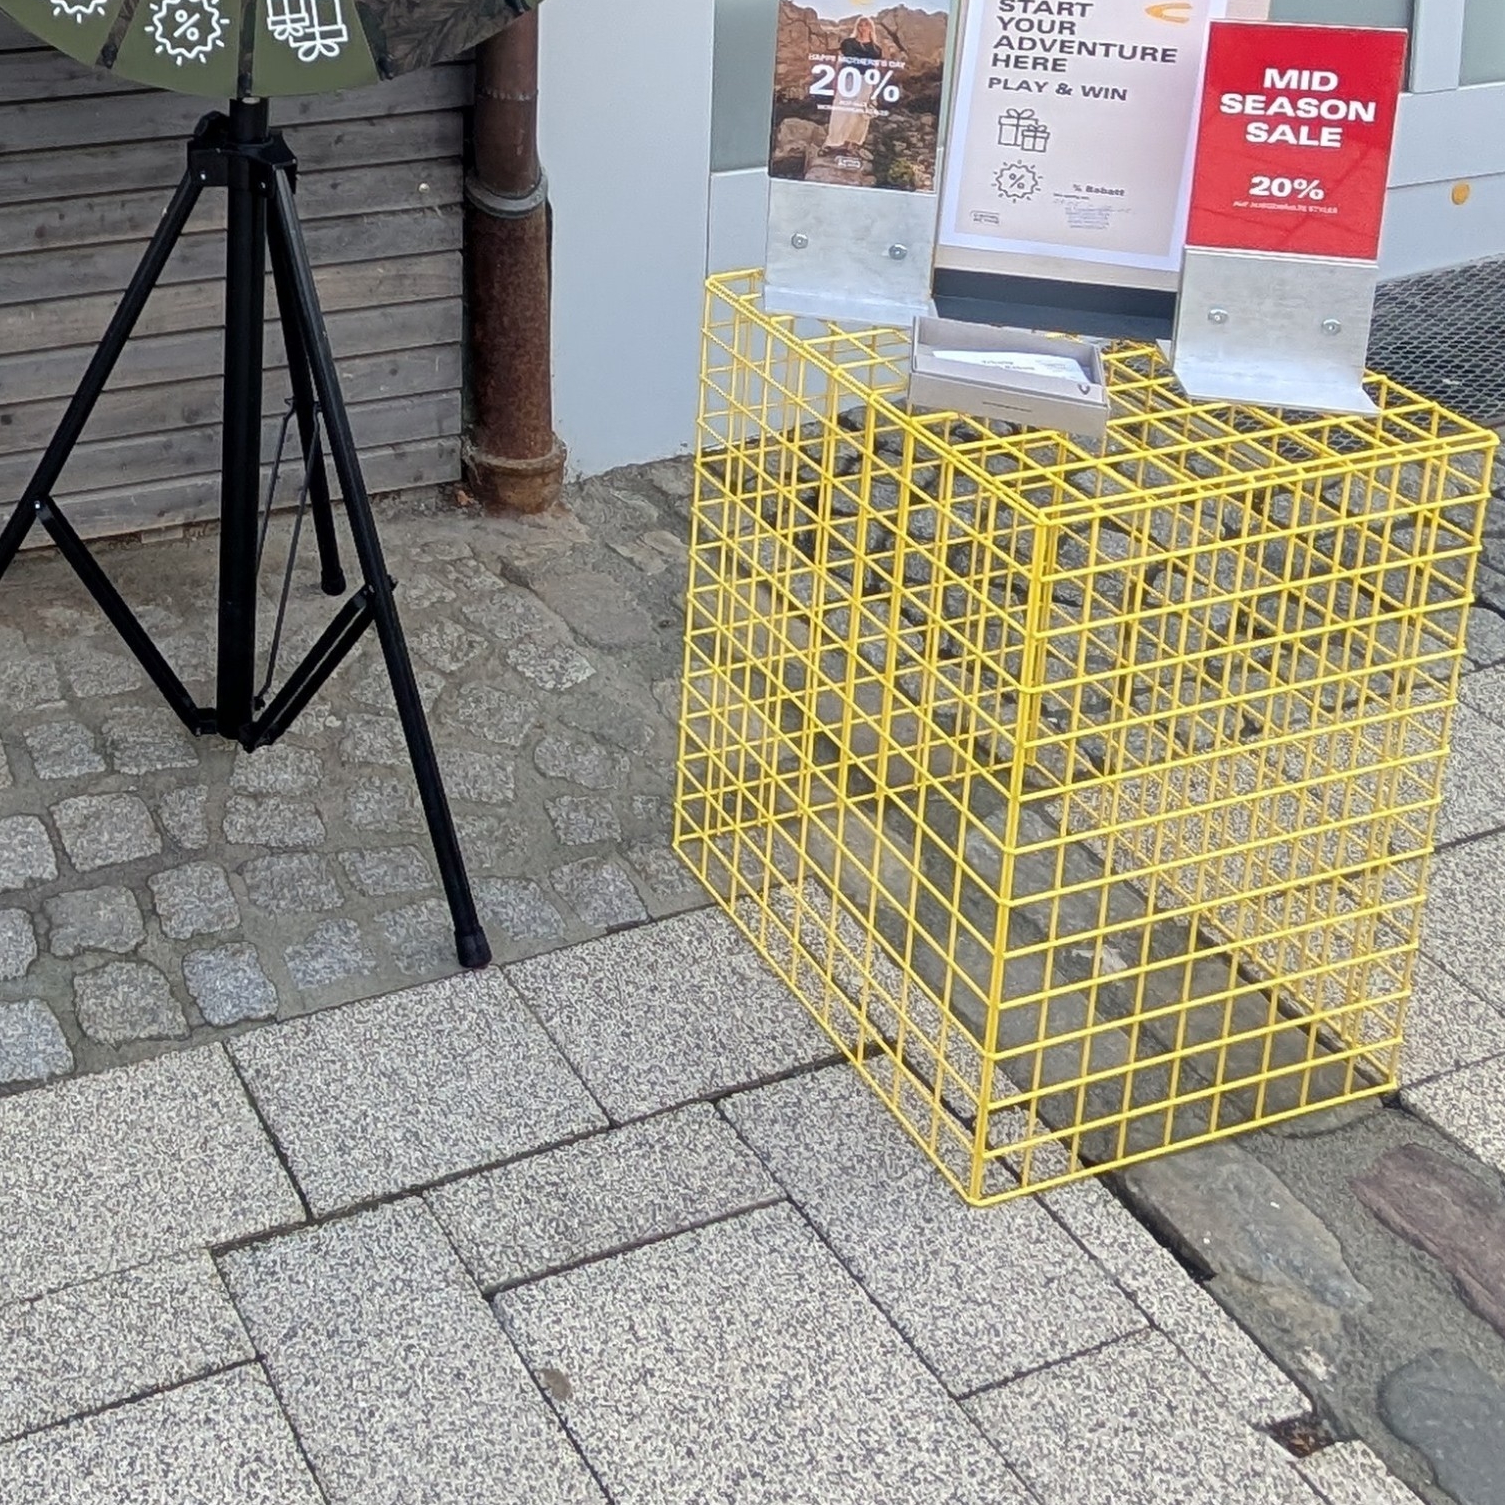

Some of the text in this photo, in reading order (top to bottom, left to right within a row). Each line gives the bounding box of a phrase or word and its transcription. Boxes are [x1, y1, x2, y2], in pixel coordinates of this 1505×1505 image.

[996, 15, 1077, 36] YOUR
[992, 34, 1179, 64] ADVENTURE
[991, 53, 1069, 73] HERE
[808, 64, 901, 103] 20%
[988, 77, 1129, 101] PLAY & WIN
[1263, 68, 1339, 92] MID
[1220, 93, 1377, 122] SEASON
[1245, 122, 1344, 148] SALE
[1248, 176, 1325, 201] 20%
